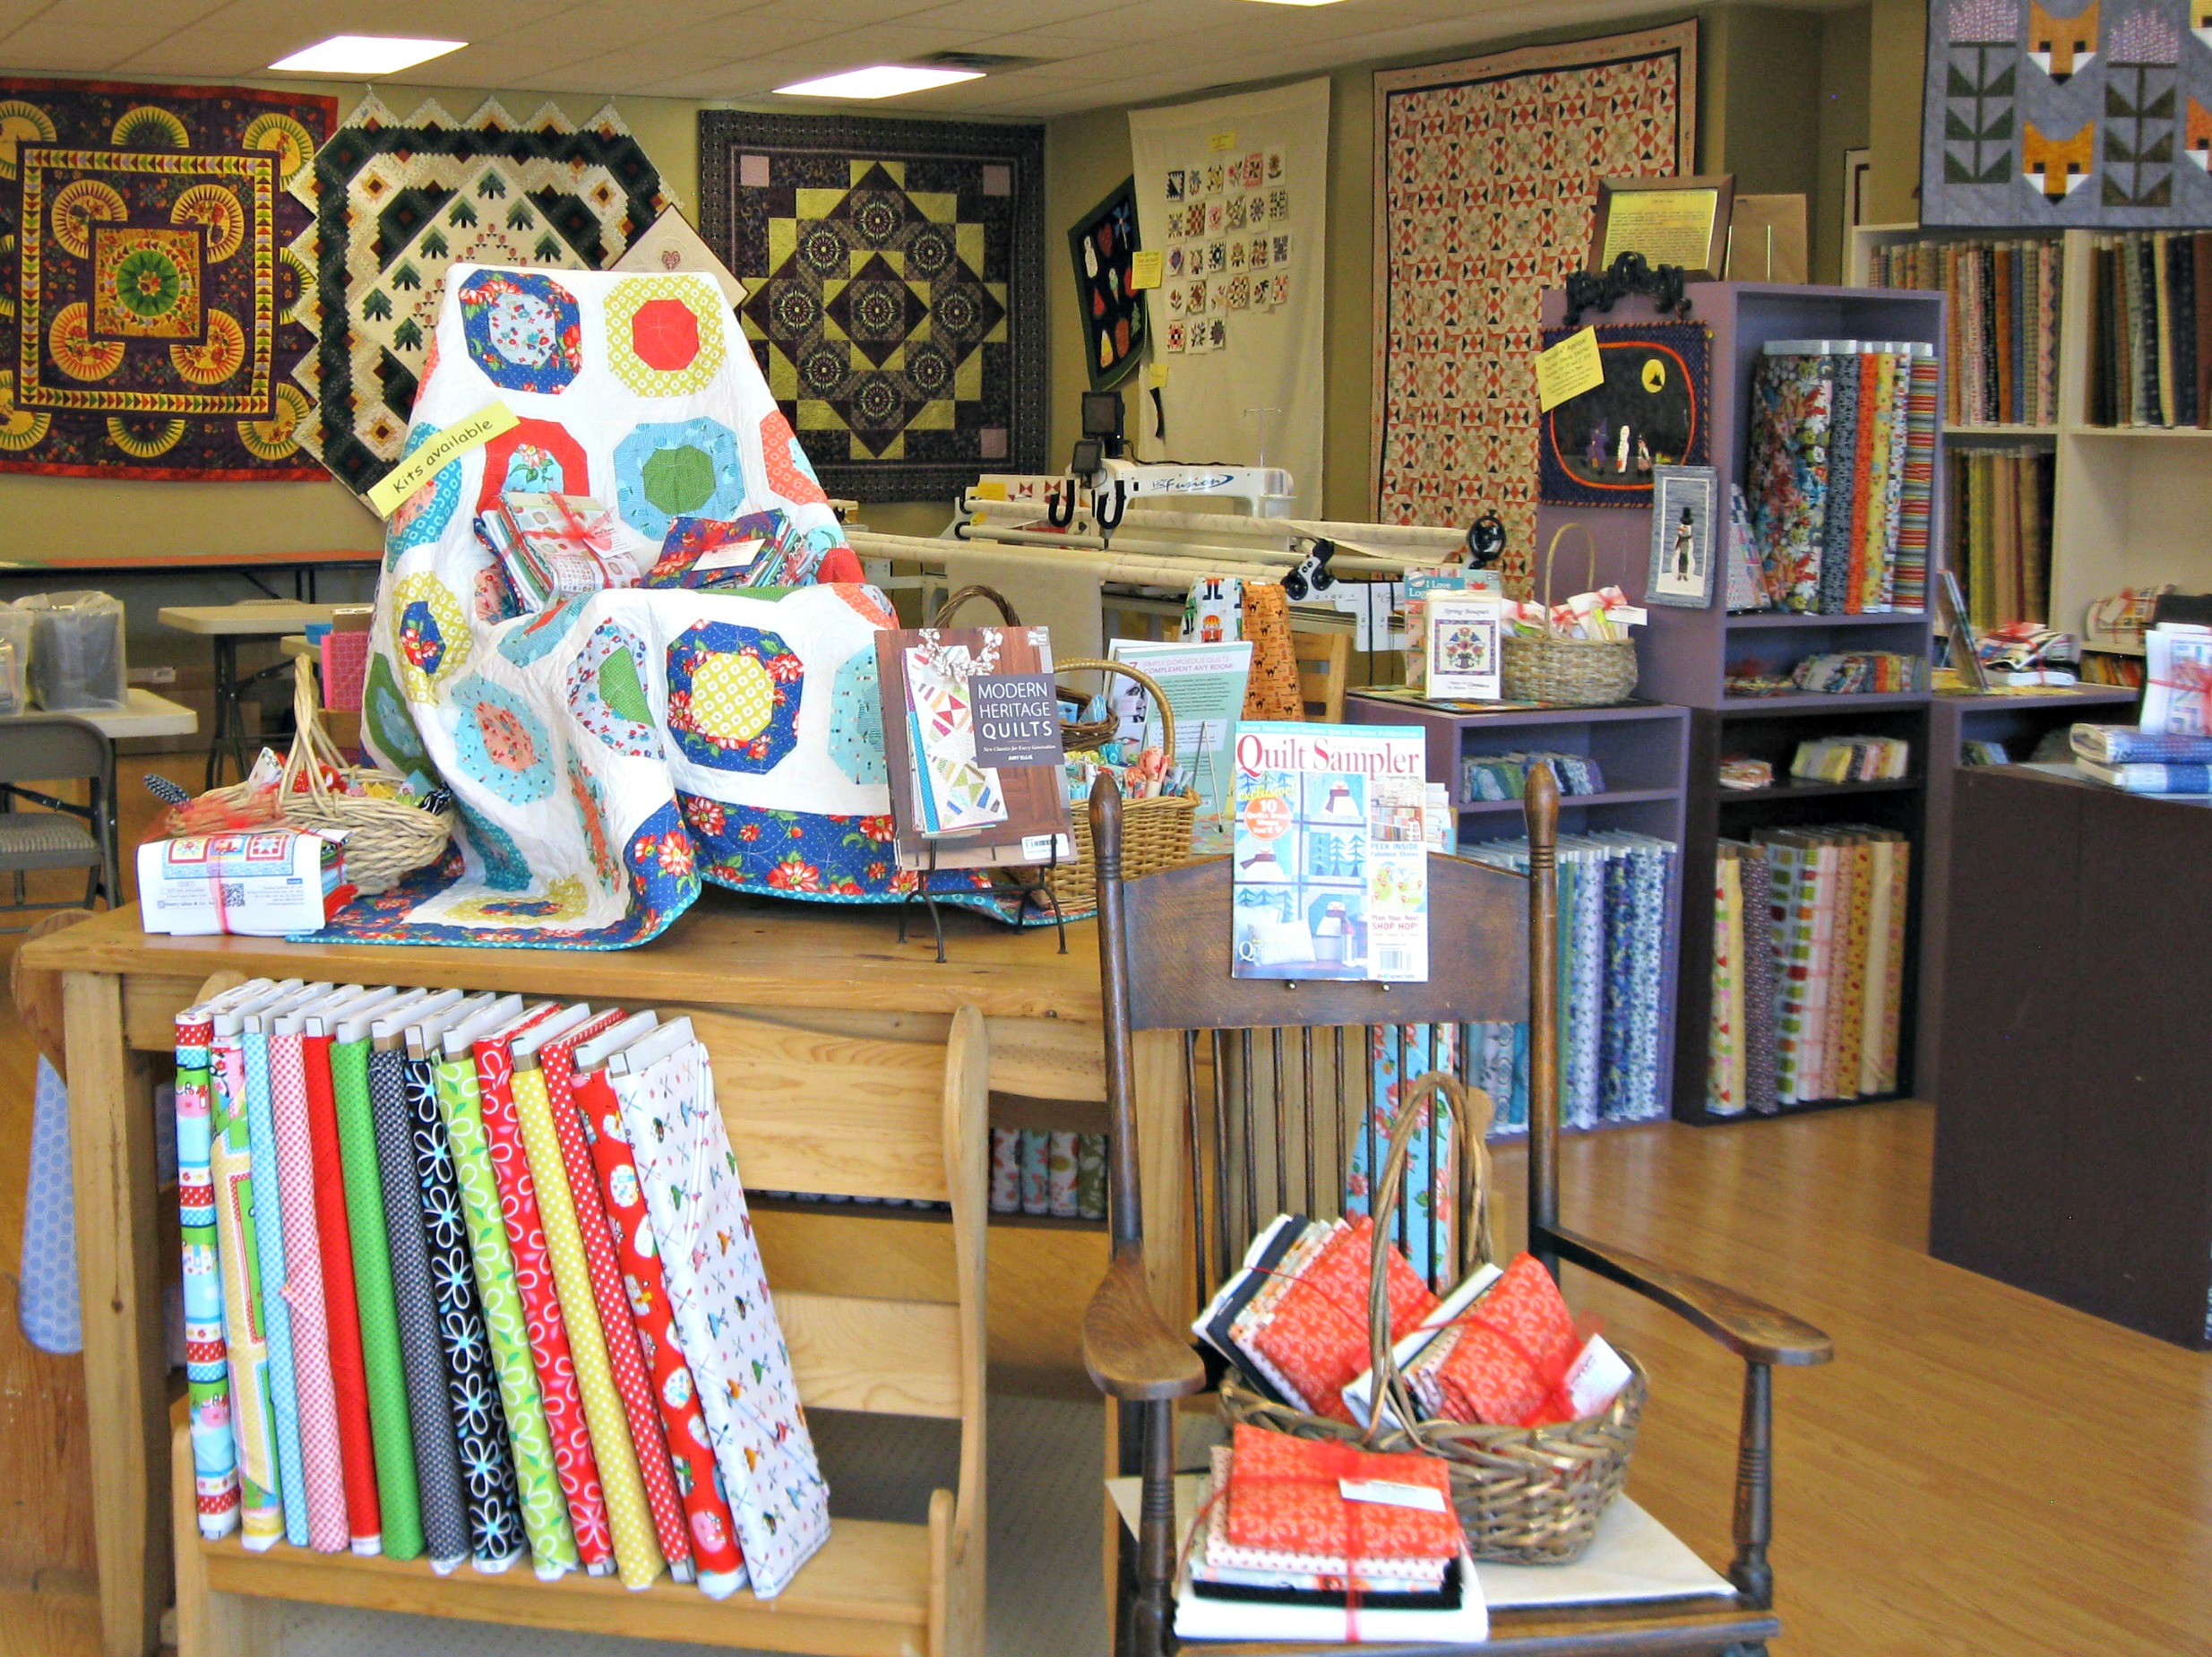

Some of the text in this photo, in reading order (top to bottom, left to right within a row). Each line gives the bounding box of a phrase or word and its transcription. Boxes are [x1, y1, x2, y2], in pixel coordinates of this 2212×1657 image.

[393, 420, 492, 493] Kits available
[1433, 581, 1451, 589] Love
[1144, 664, 1192, 674] COMPLEMENT
[1193, 663, 1209, 671] ANY
[977, 682, 1048, 699] MODERN
[979, 702, 1052, 719] HERITAGE
[982, 721, 1053, 740] QUILTS
[1236, 734, 1306, 777] Quilt
[1313, 737, 1420, 781] Sampler
[1259, 799, 1278, 813] 10
[1372, 922, 1395, 930] SHOP
